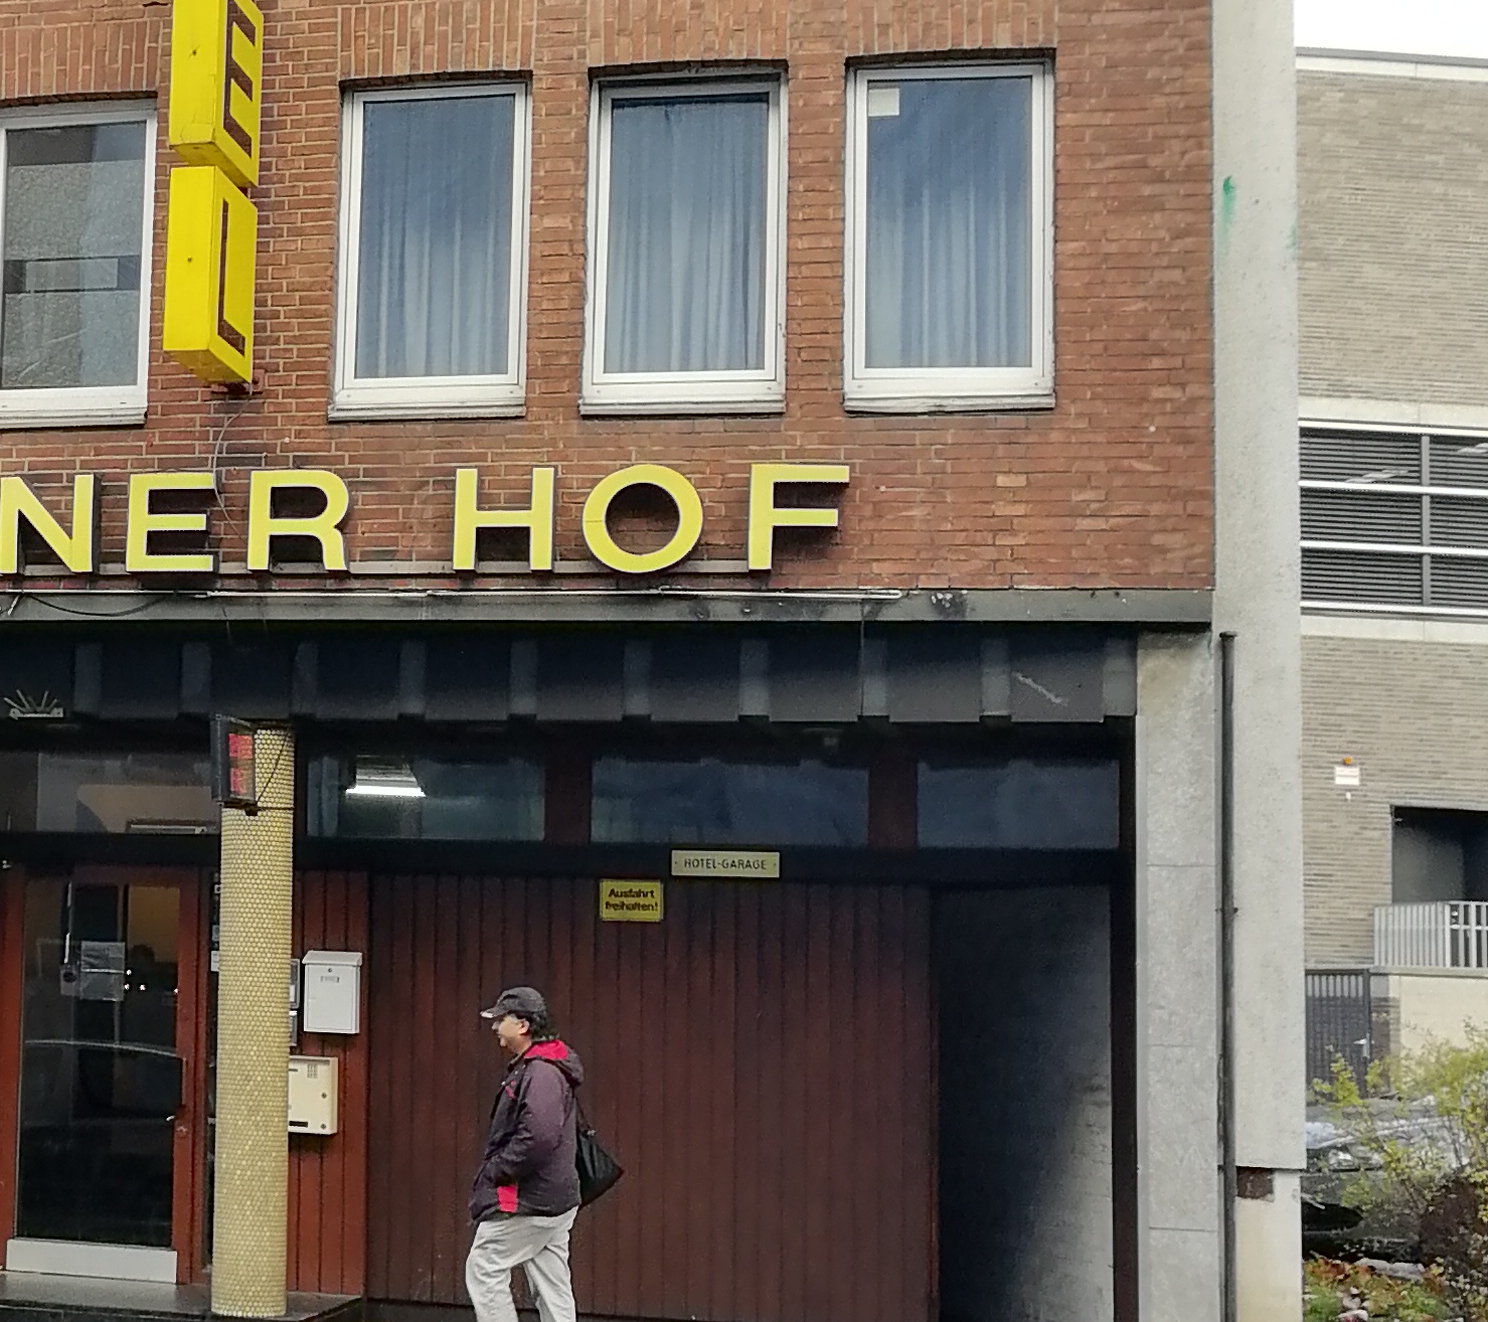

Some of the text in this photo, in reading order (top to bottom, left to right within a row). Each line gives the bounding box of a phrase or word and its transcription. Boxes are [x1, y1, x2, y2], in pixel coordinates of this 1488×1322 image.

[452, 461, 851, 573] HOF
[684, 858, 767, 870] HOTEL-GARAGE
[608, 888, 654, 898] Ausfahrt
